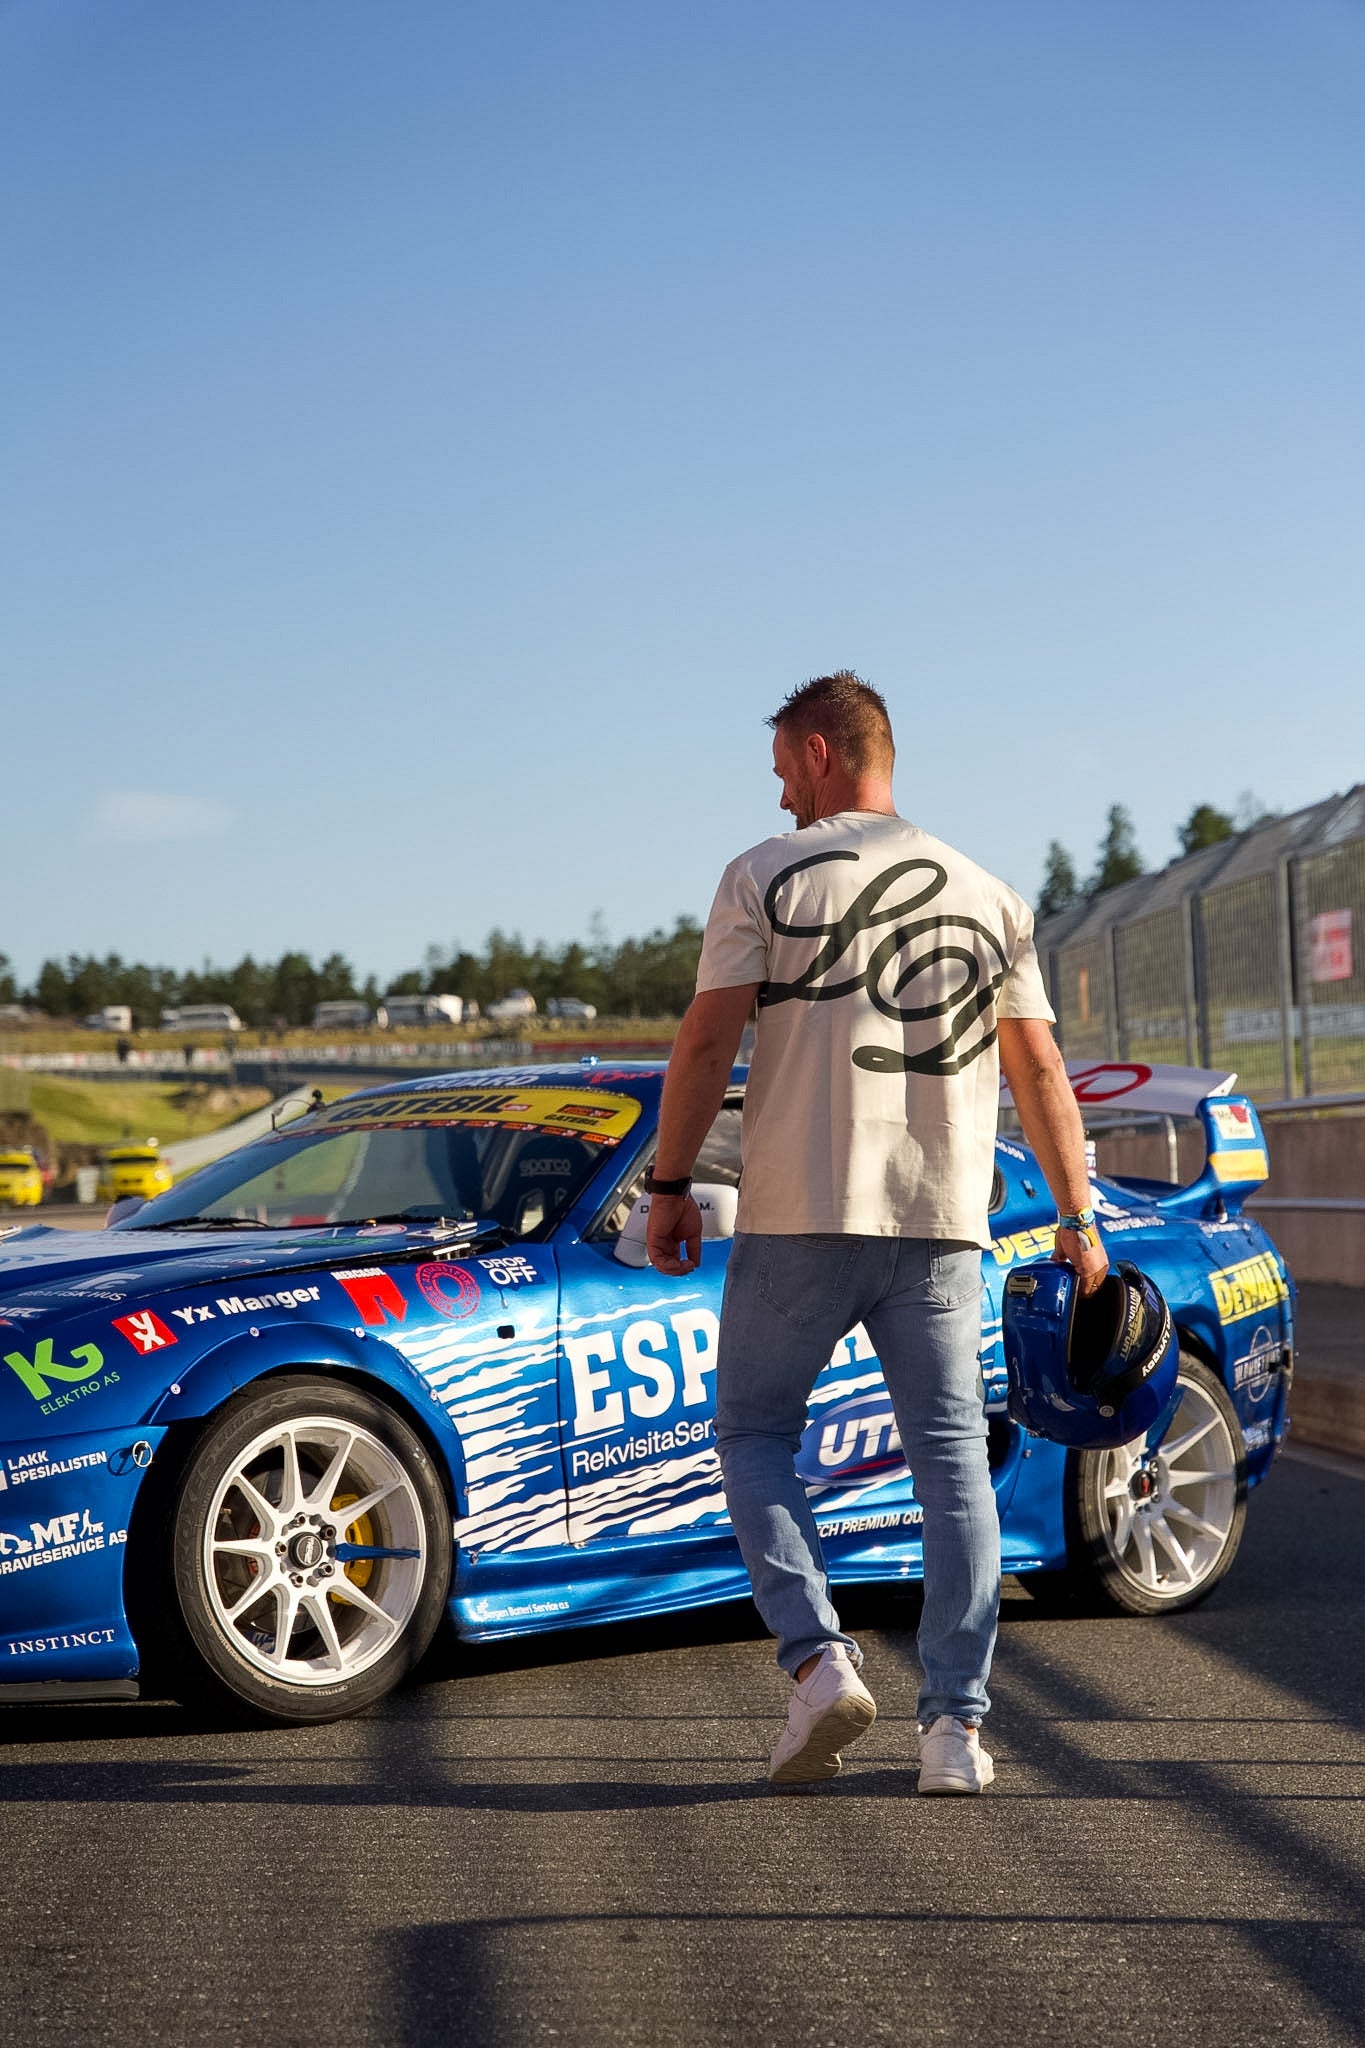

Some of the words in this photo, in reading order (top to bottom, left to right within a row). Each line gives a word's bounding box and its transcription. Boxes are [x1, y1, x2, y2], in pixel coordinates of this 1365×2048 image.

[328, 1095, 520, 1122] GATEBIL
[478, 1256, 527, 1270] DROP
[488, 1265, 538, 1286] OFF
[171, 1305, 216, 1326] Yx
[215, 1286, 321, 1316] Manger
[40, 1381, 101, 1416] ELEKTRO
[103, 1371, 122, 1388] AS
[7, 1450, 49, 1471] LAKK
[10, 1451, 108, 1486] SPESIALISTEN
[29, 1512, 80, 1551] MF
[108, 1529, 128, 1546] AS
[840, 1513, 901, 1535] PREMIUM
[8, 1628, 116, 1656] INSTINCT
